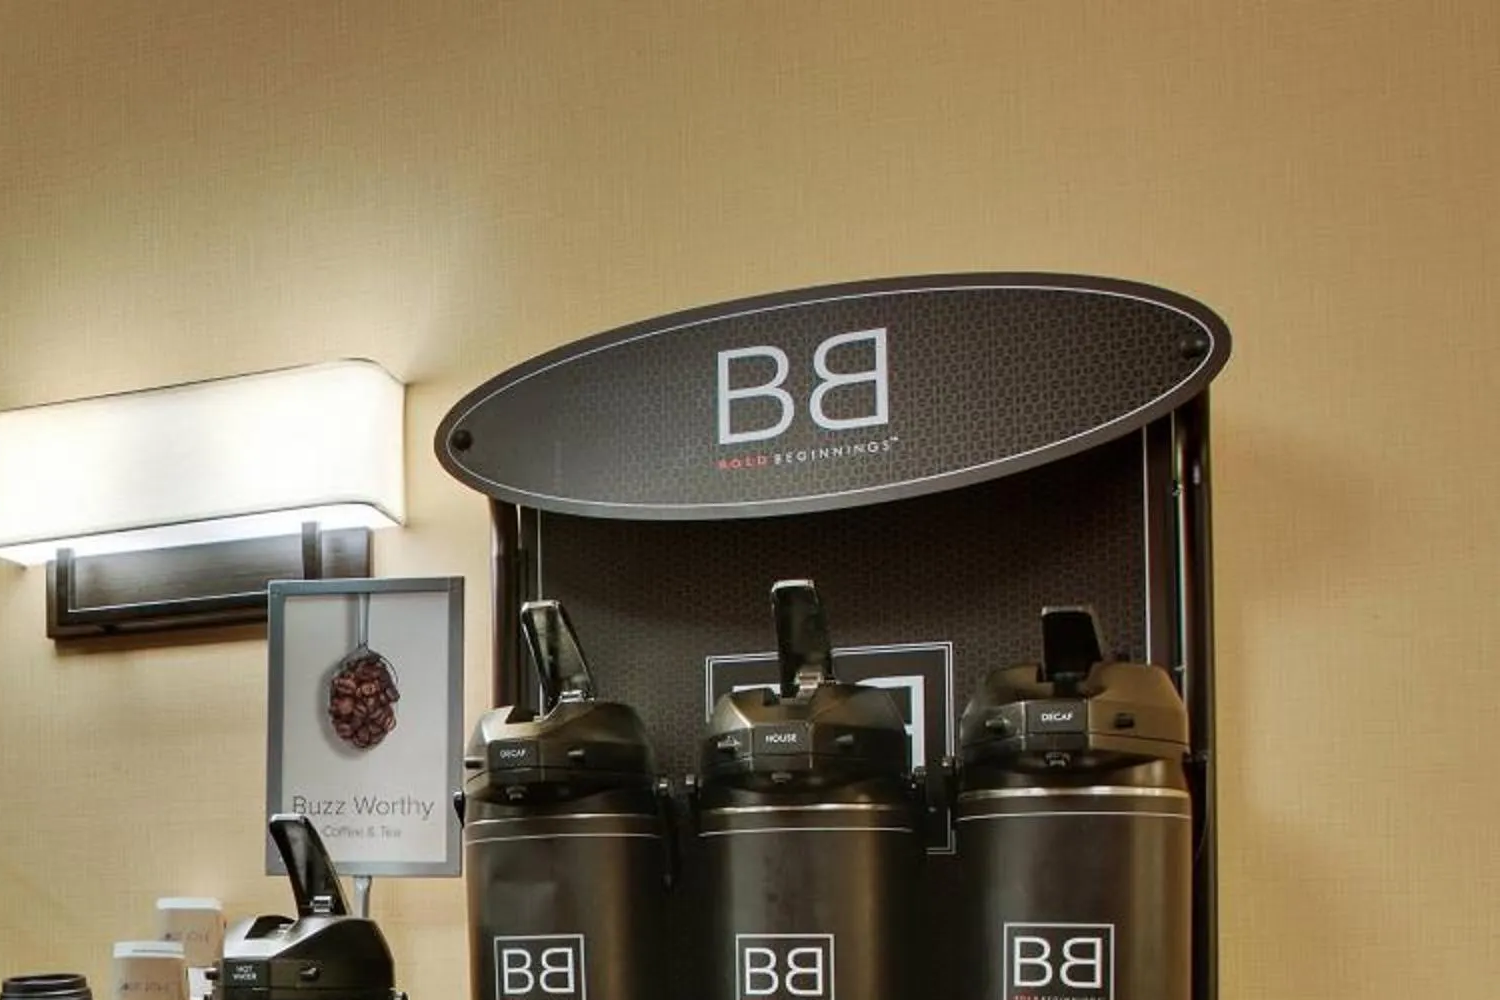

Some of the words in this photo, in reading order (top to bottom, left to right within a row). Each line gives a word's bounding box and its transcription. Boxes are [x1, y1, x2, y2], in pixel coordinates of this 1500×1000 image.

[716, 454, 769, 470] BOLD
[292, 795, 346, 816] Buzz
[353, 794, 435, 821] Worthy
